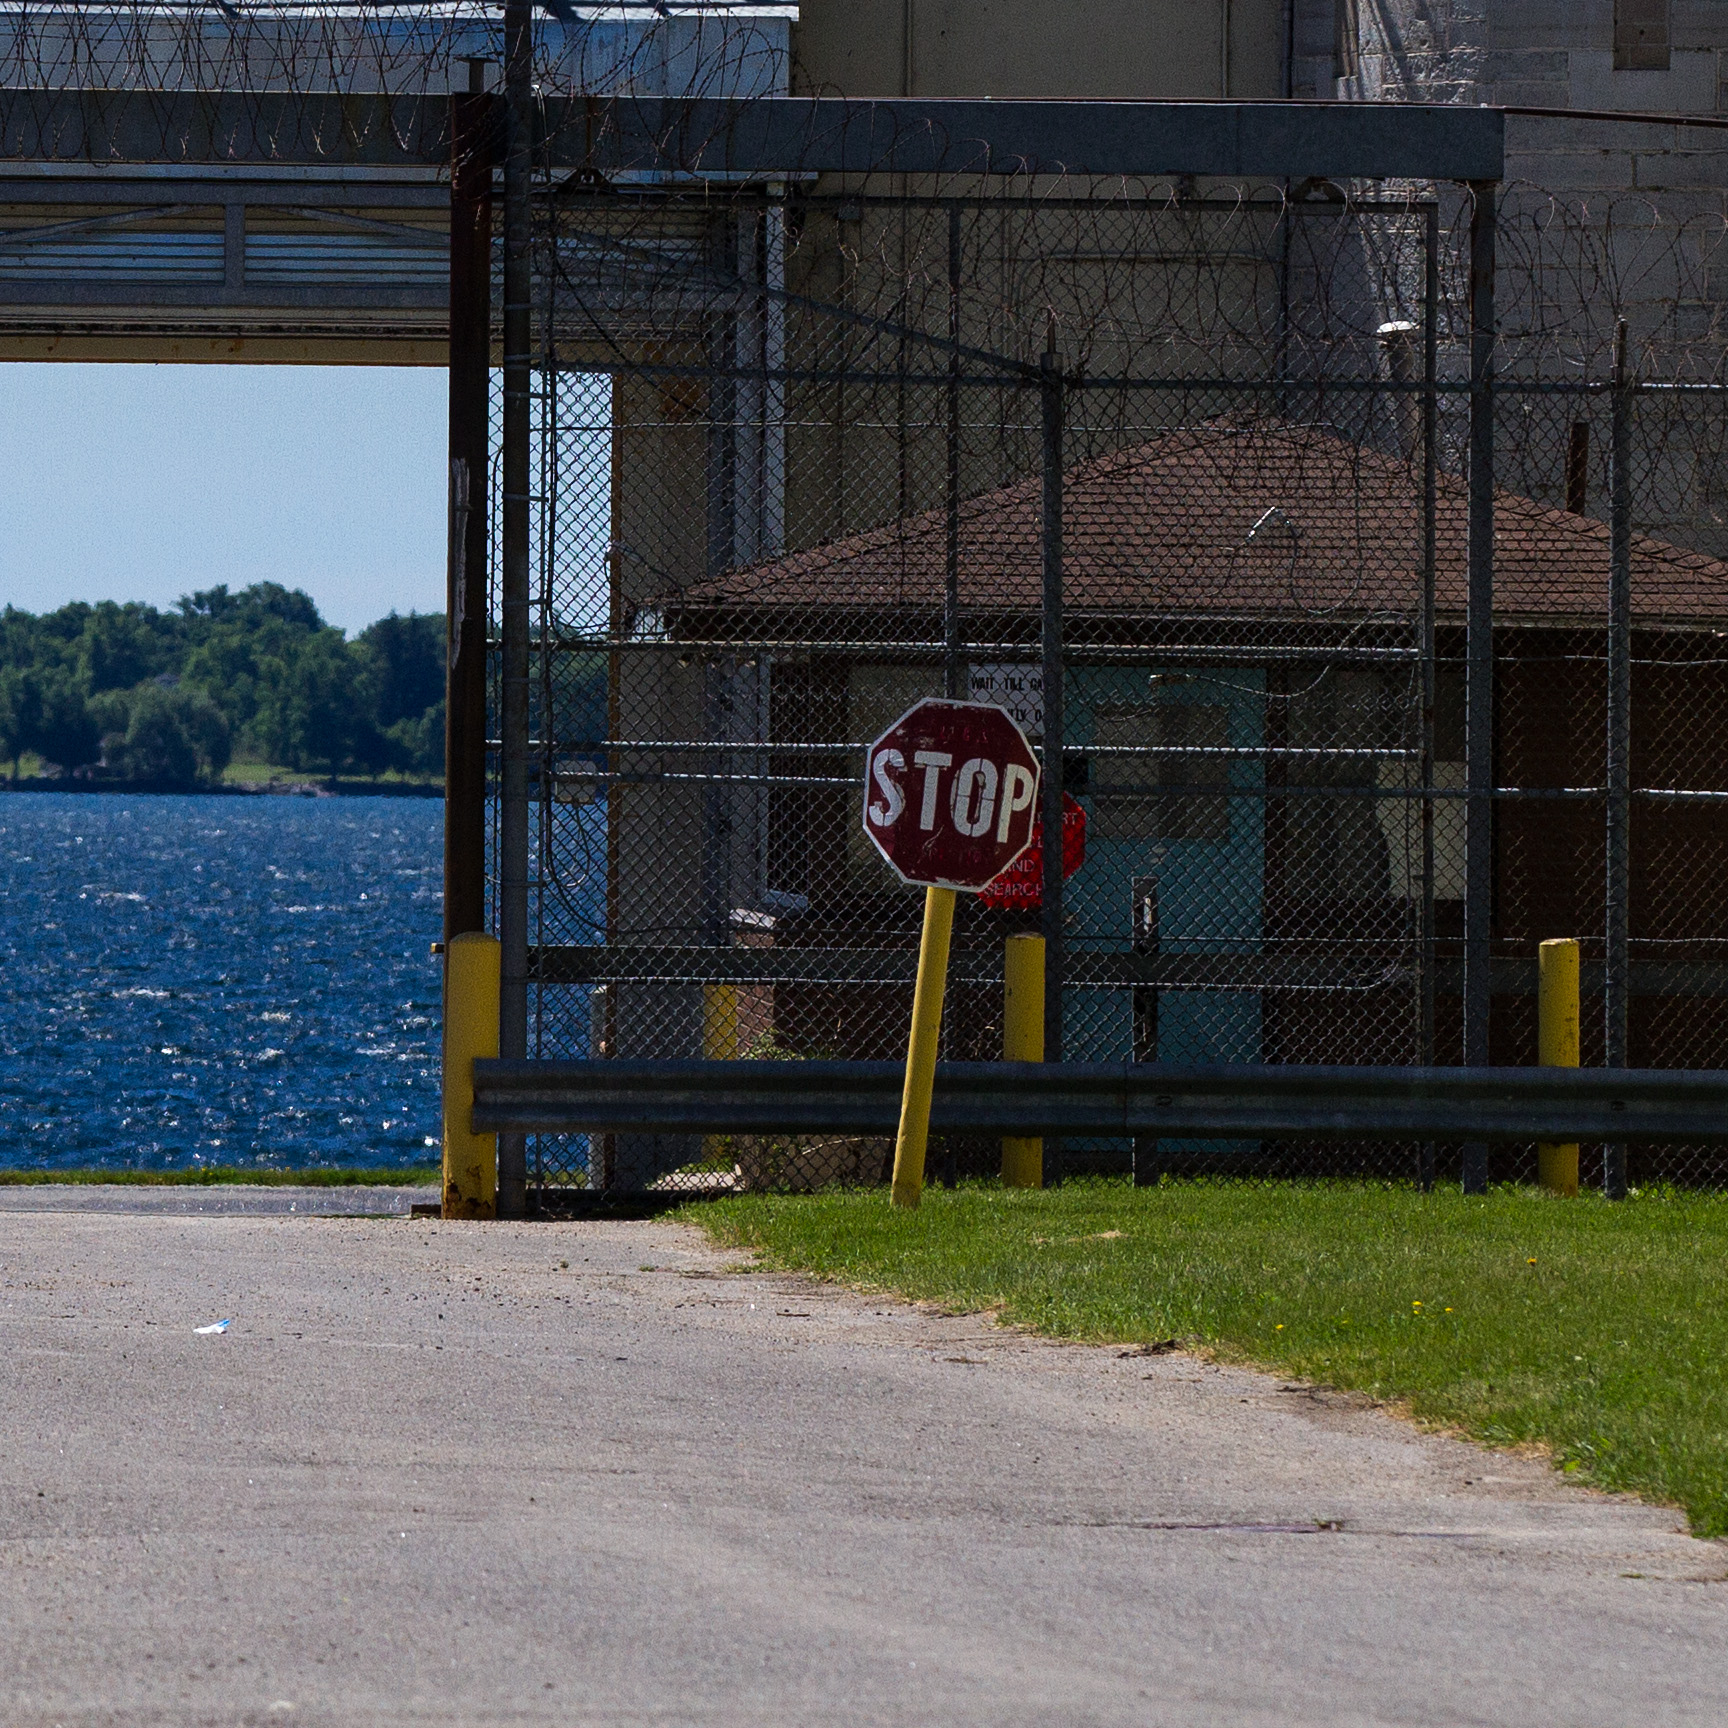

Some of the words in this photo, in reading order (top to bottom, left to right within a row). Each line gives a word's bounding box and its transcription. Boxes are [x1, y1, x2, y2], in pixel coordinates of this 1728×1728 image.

[971, 677, 994, 690] WAIT
[1004, 676, 1025, 691] TILL
[869, 748, 1034, 843] STOP
